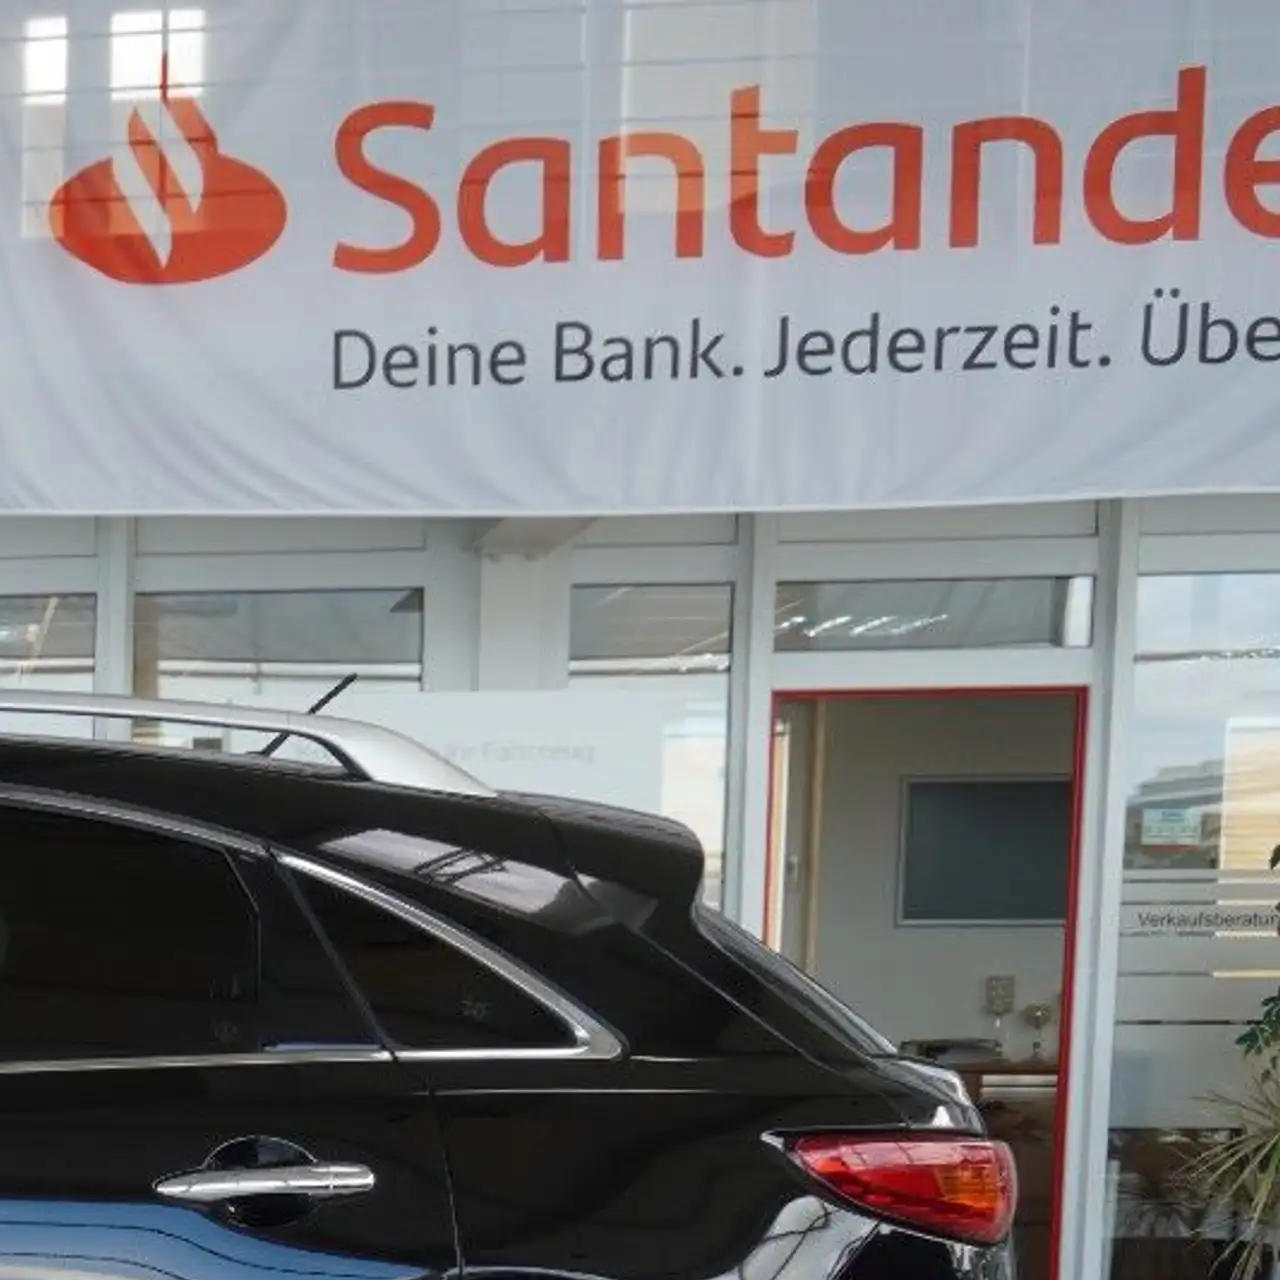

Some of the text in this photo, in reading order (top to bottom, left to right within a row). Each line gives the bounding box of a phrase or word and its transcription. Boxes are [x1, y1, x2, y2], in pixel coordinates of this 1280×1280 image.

[331, 65, 1280, 276] Santande
[332, 287, 1280, 390] Deine Bank. Jederzeit. Übe
